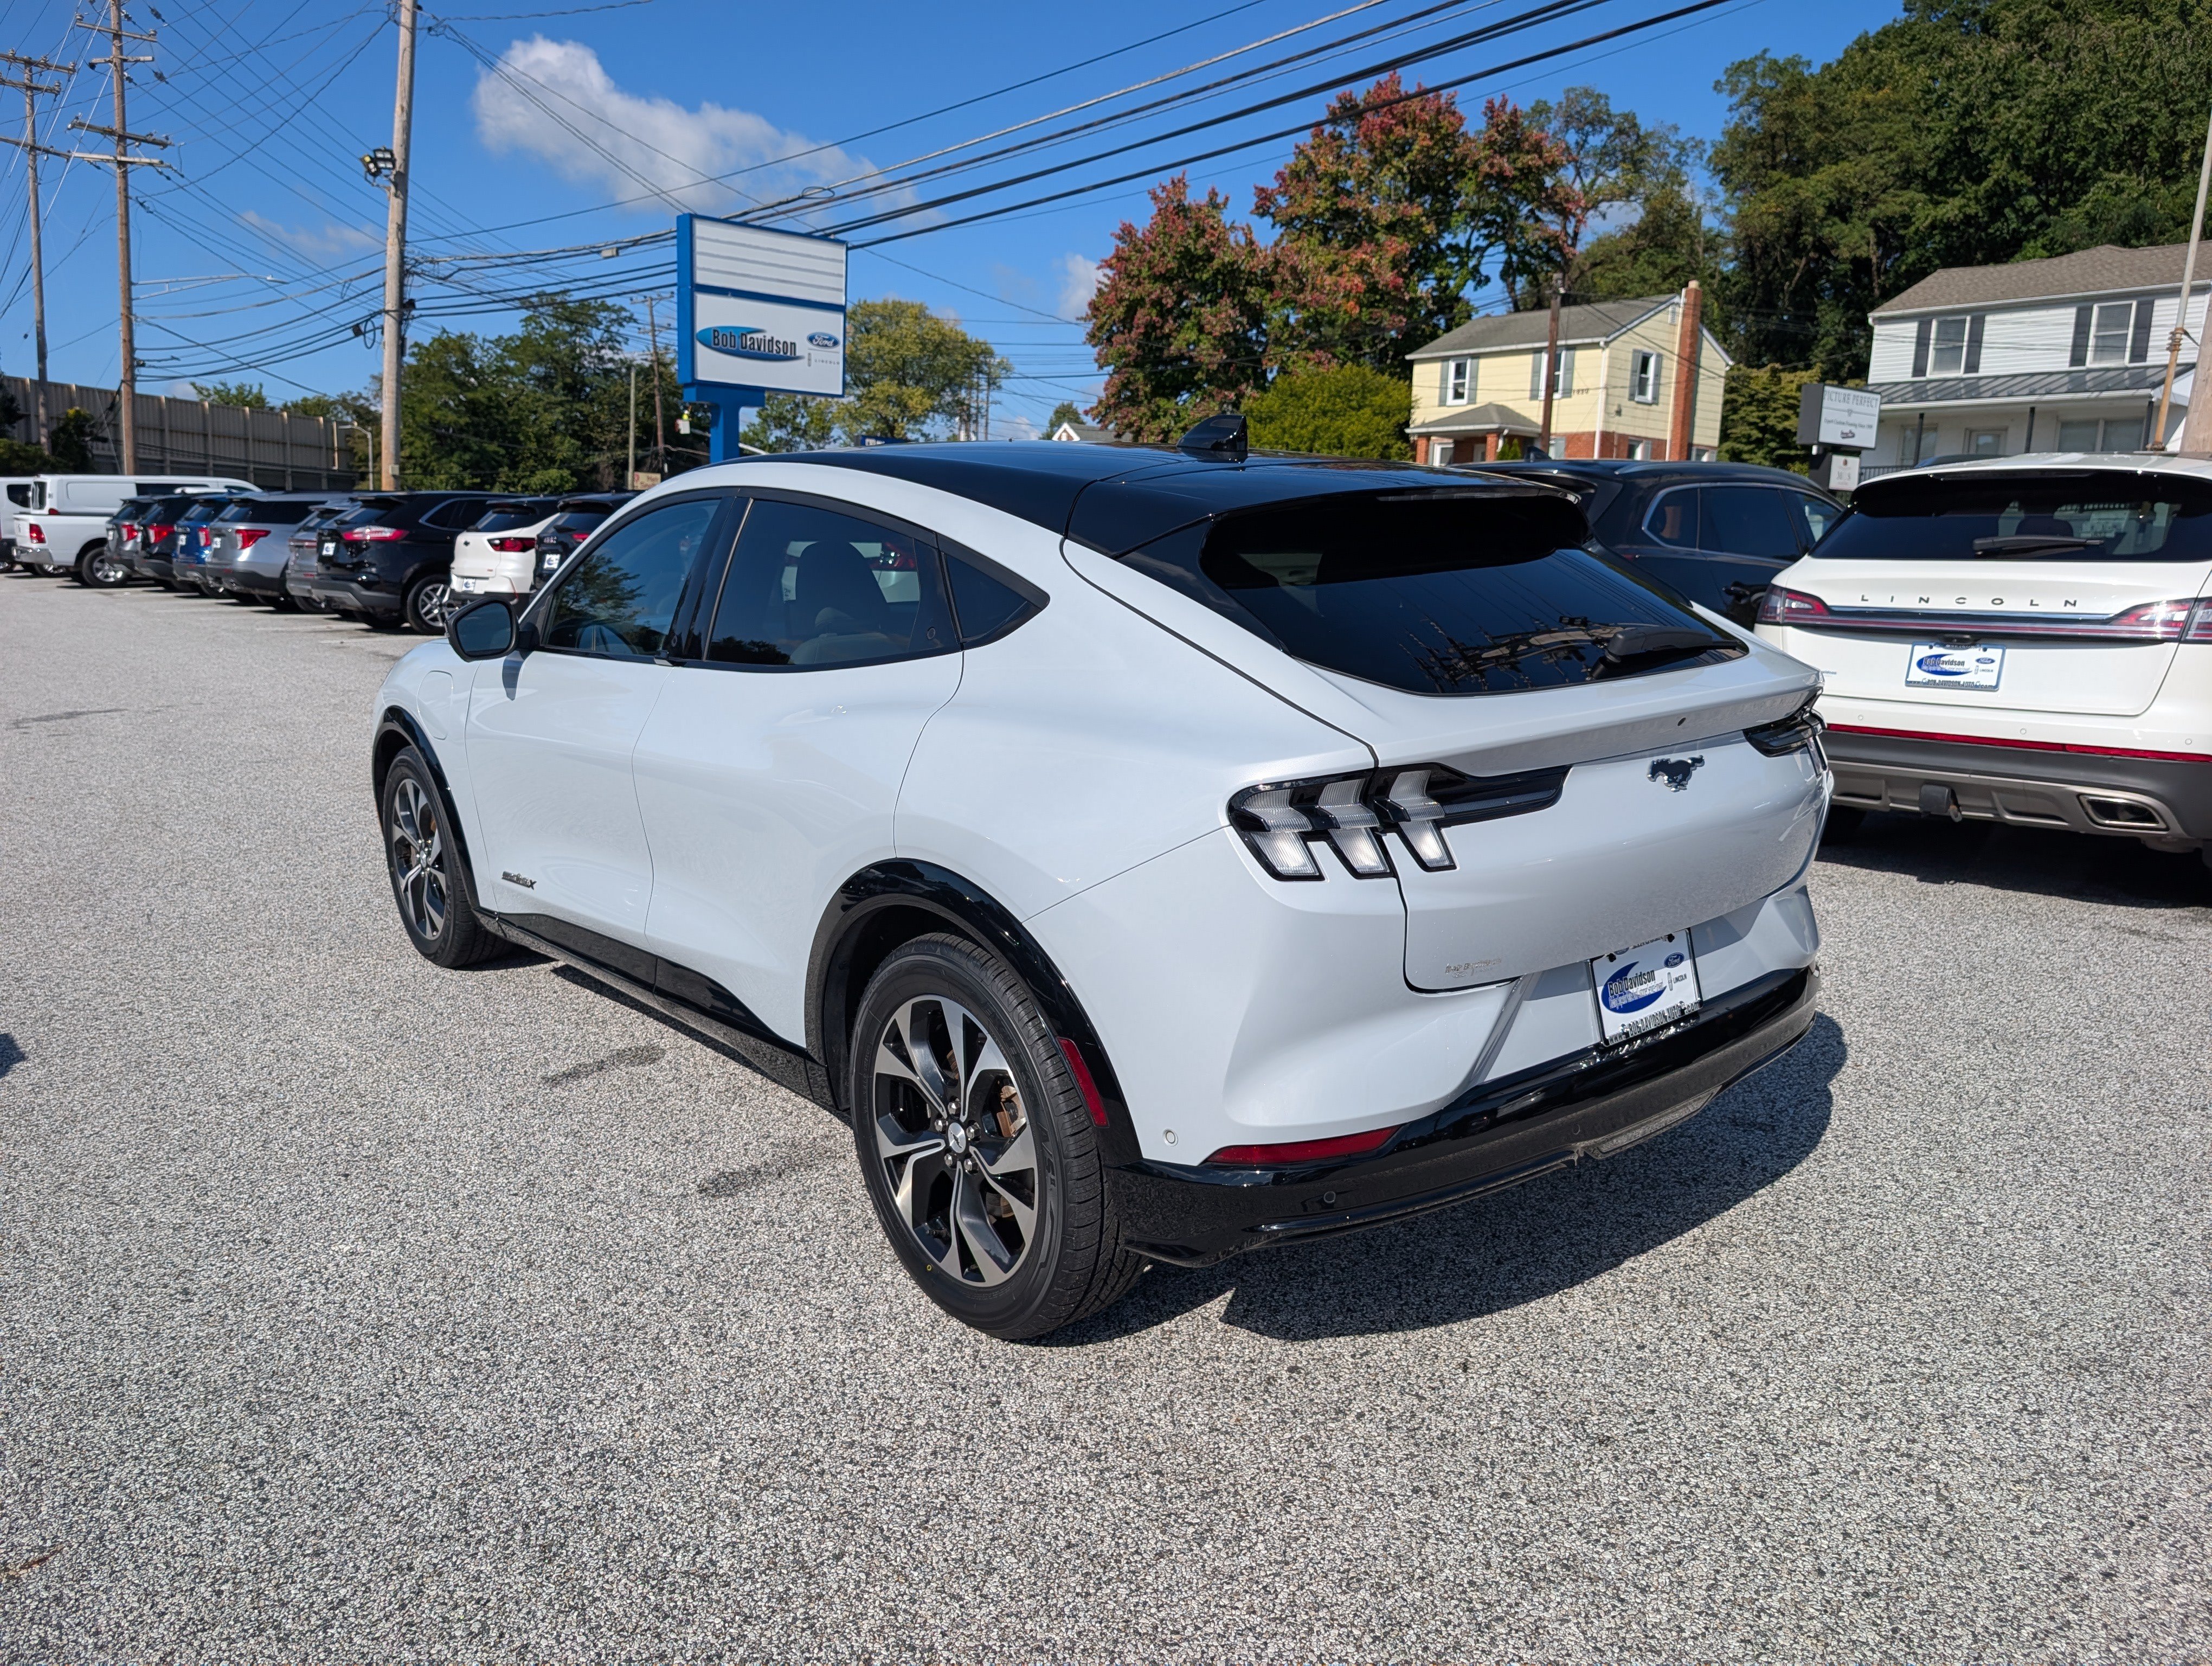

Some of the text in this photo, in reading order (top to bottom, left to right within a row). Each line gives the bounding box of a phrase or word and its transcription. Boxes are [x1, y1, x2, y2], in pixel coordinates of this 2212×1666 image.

[712, 328, 796, 357] Bob Davidson
[812, 334, 835, 347] Ford
[1823, 390, 1879, 408] PICTURE PERFECT
[1860, 594, 2078, 608] LINCOLN
[1924, 657, 1965, 667] Bob Davidson
[1608, 979, 1623, 996] Bob
[1623, 969, 1656, 991] Davidson
[1673, 973, 1687, 984] LINCOLN
